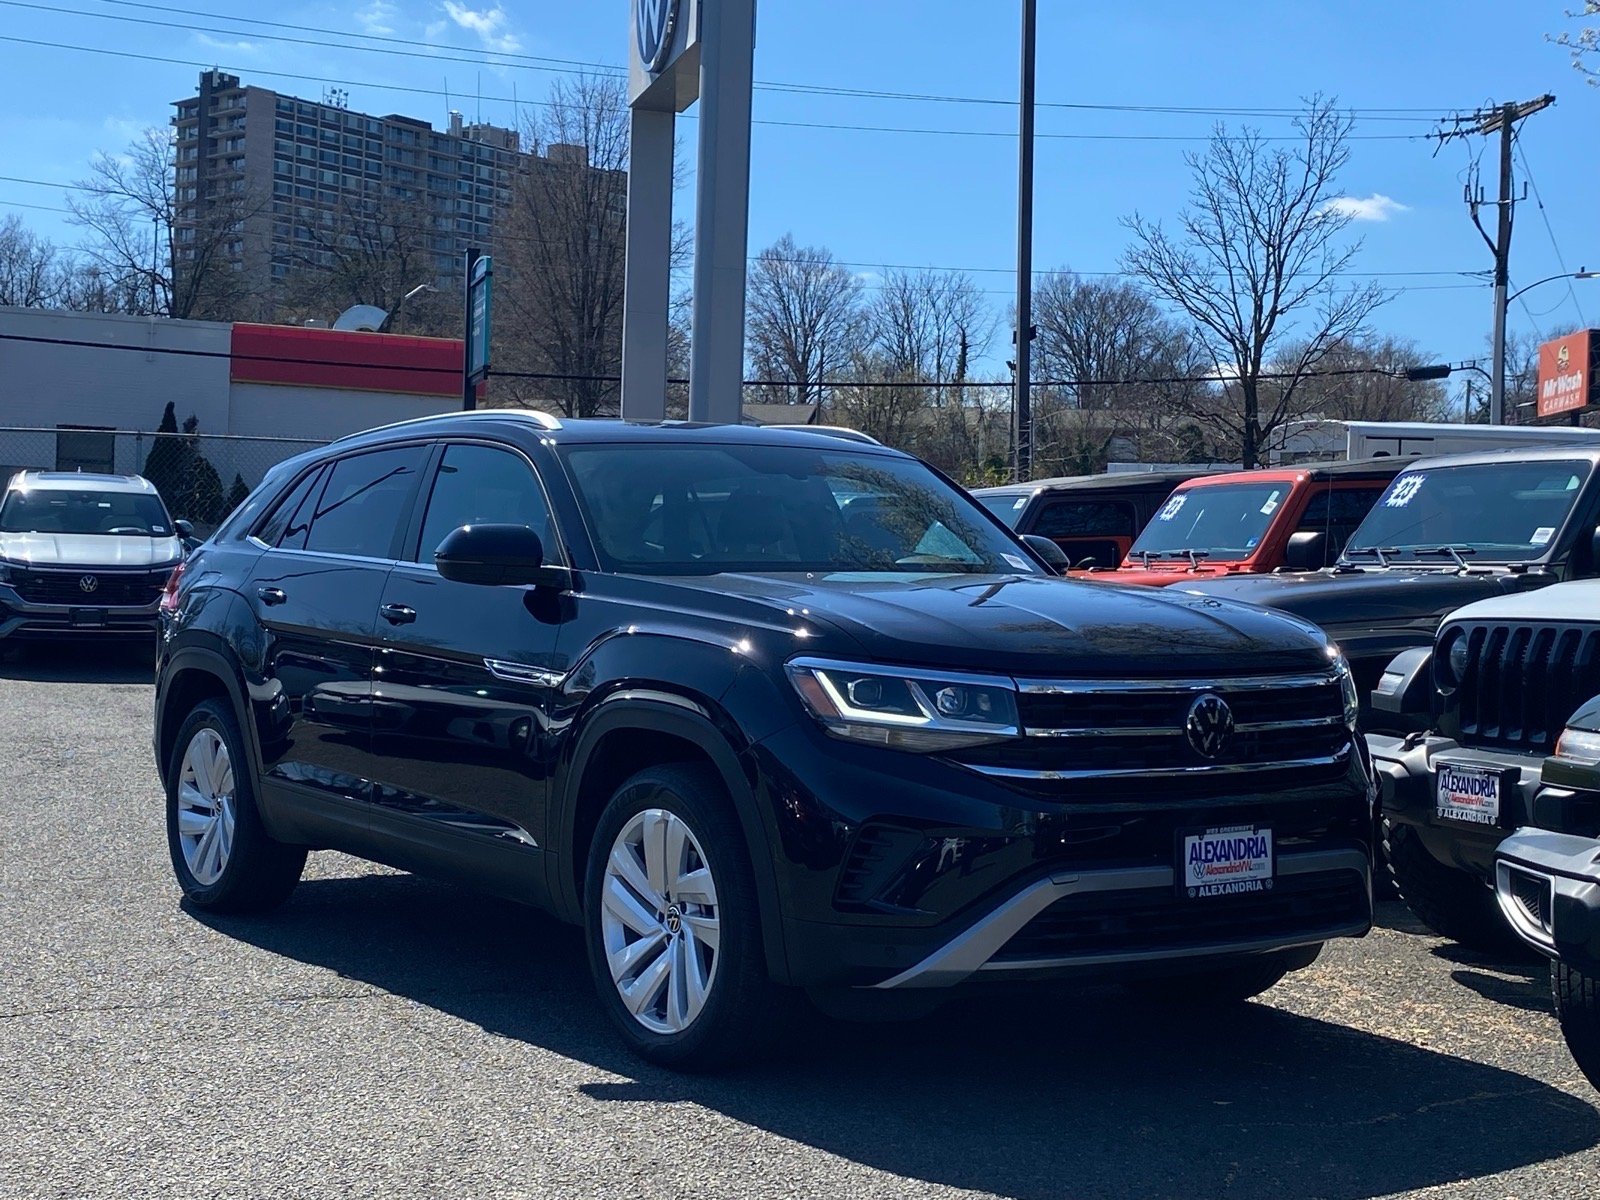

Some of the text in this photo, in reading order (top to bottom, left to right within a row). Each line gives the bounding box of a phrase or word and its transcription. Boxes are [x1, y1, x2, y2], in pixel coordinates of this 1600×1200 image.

[1440, 773, 1496, 798] ALEXANDRIA
[1443, 809, 1490, 825] ALEXANDRIA
[1188, 836, 1268, 865] ALEXANDRIA
[1199, 880, 1264, 897] ALEXANDRIA
